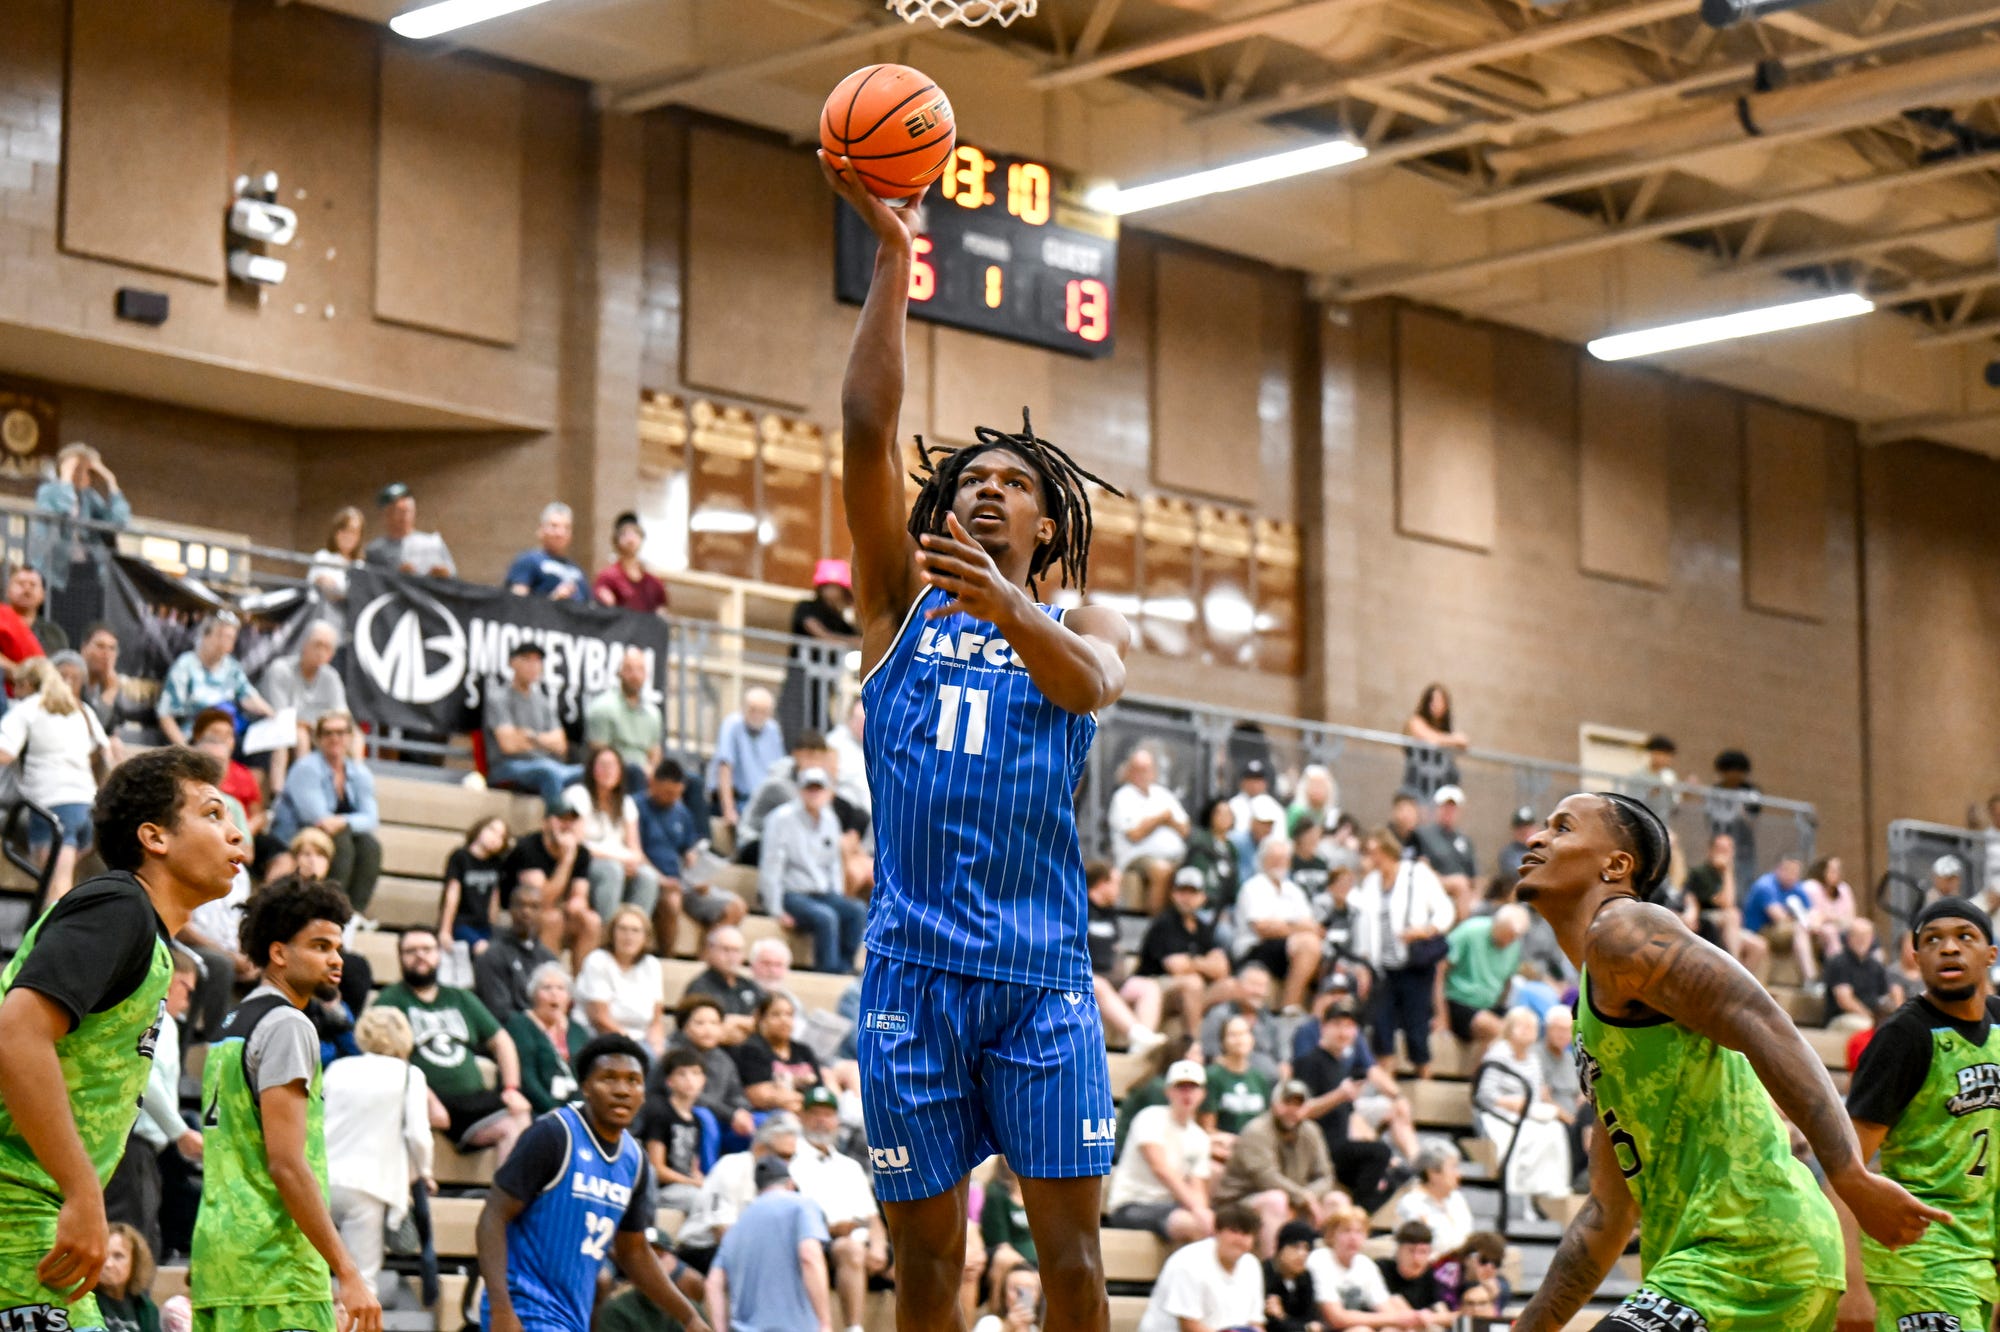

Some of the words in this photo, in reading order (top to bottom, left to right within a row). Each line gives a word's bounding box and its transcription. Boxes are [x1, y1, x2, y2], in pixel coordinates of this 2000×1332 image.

[985, 265, 1002, 308] 1
[1065, 279, 1108, 341] 13
[936, 684, 989, 756] 11
